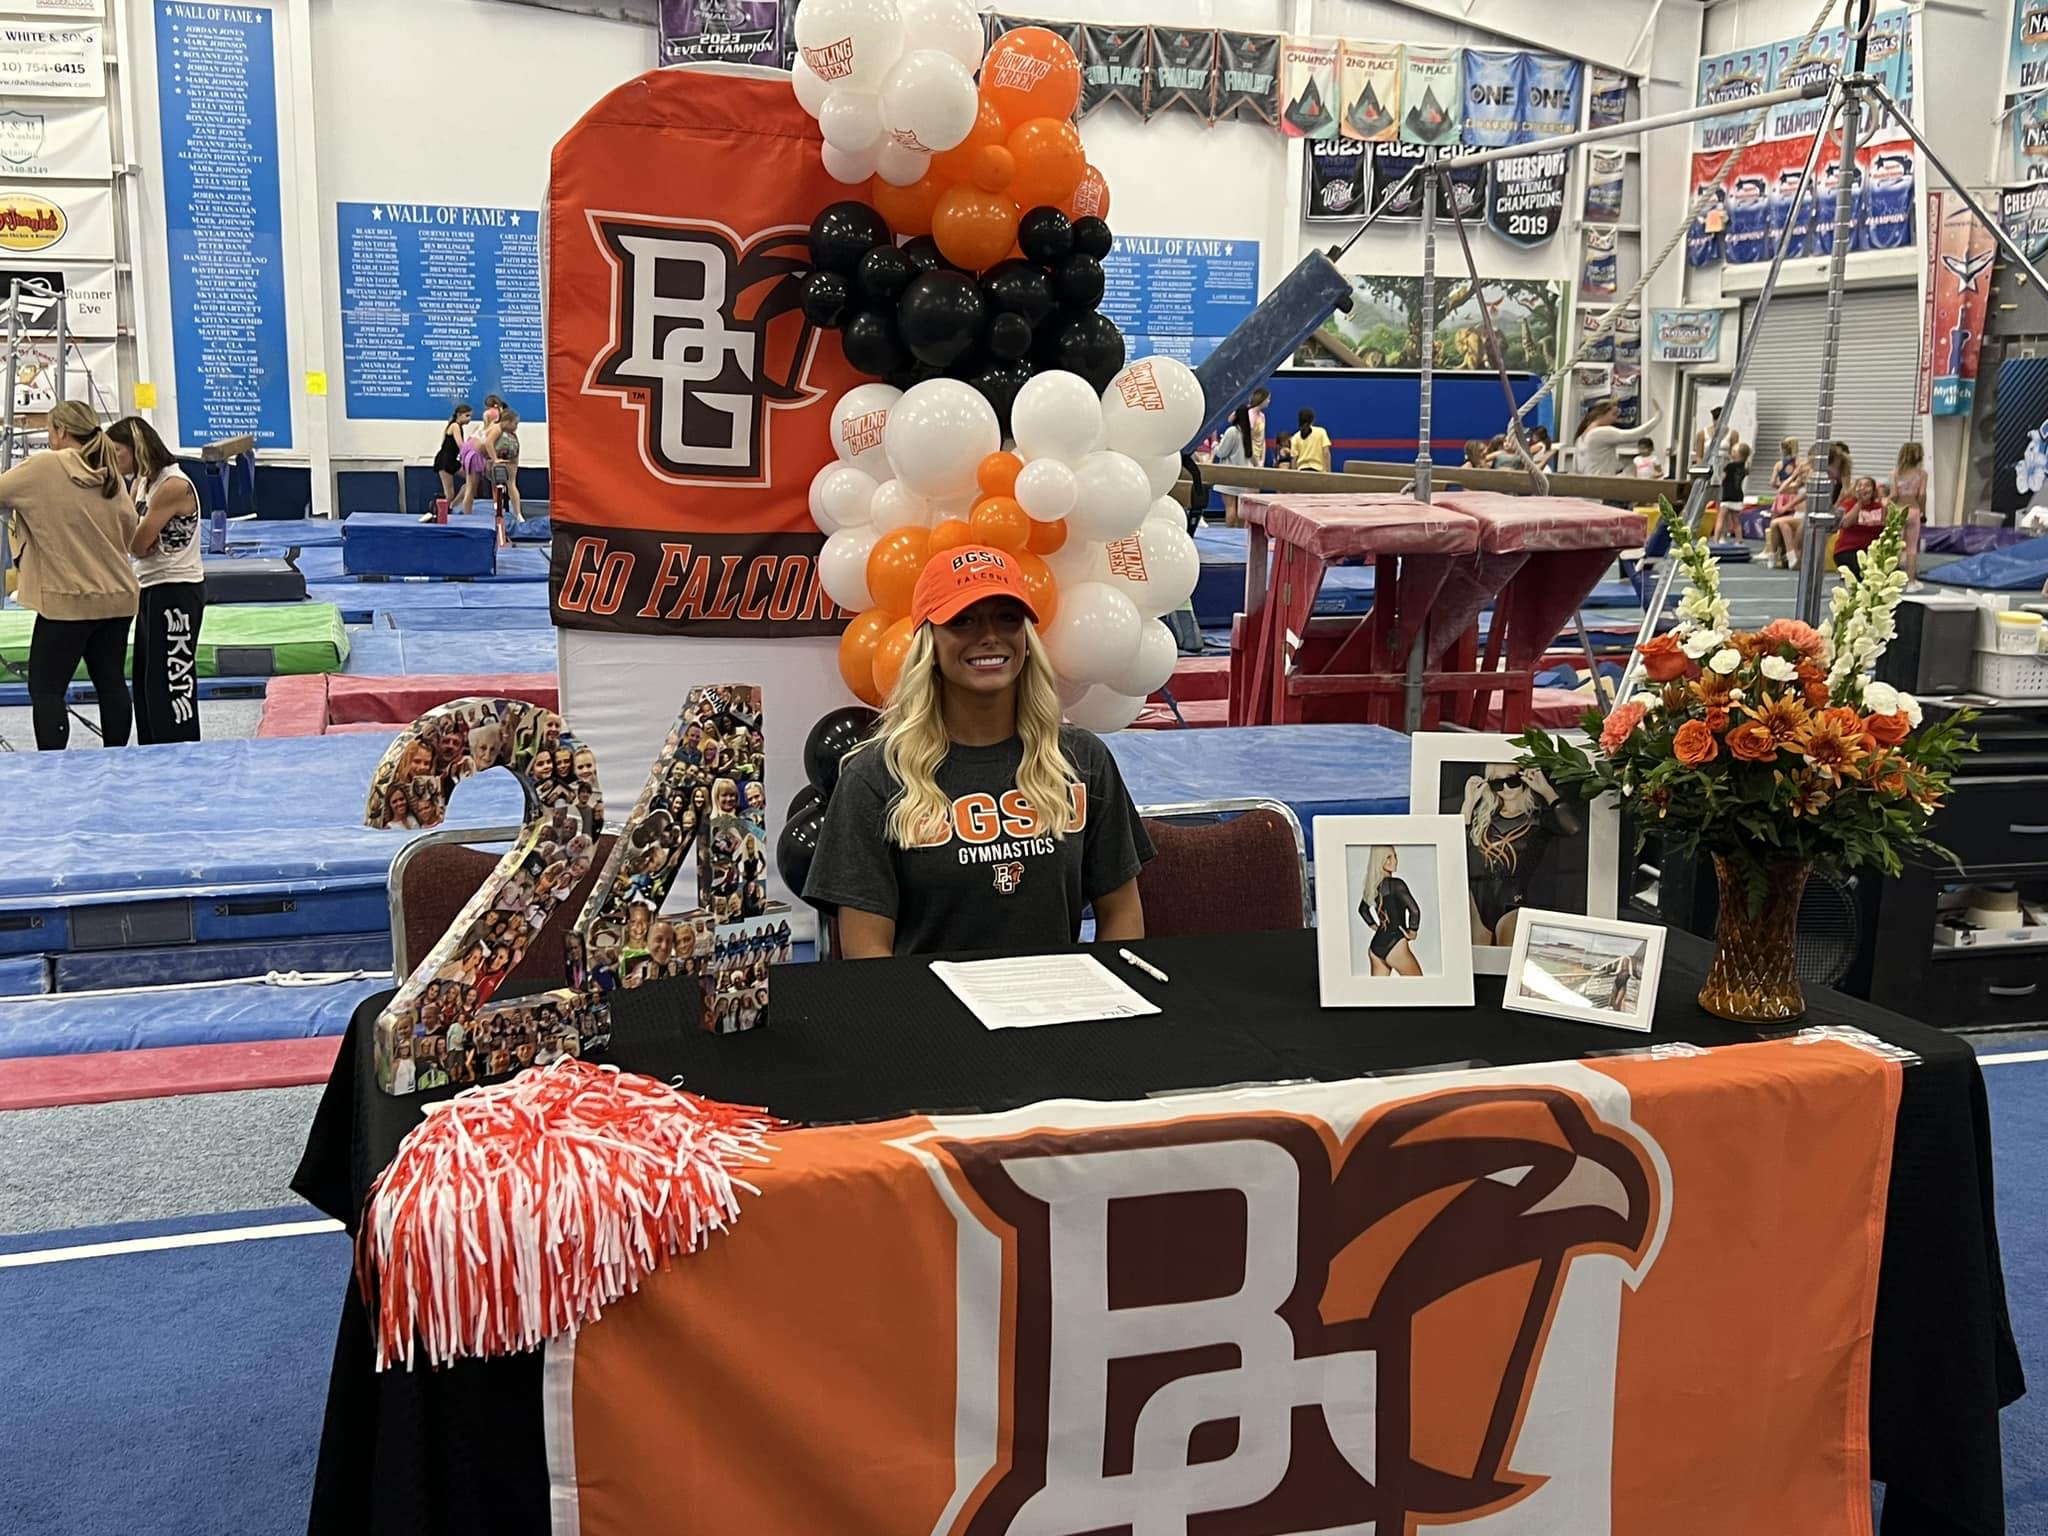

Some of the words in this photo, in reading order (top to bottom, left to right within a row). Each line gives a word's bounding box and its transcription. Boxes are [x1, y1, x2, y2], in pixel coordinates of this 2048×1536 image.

[175, 5, 205, 19] WALL
[208, 8, 222, 20] OF
[224, 9, 253, 23] FAME
[5, 31, 46, 42] WHITE
[186, 26, 217, 34] JORDAN
[700, 33, 740, 44] 2023
[210, 40, 247, 48] JOHNSON
[667, 45, 704, 56] LEVEL
[708, 42, 774, 54] CHAMPION
[26, 62, 86, 74] 754-6415
[994, 48, 1052, 80] BOWLING
[1287, 54, 1335, 66] CHAMPION
[1346, 58, 1365, 69] 2ND
[1368, 60, 1394, 70] PLACE
[212, 78, 248, 87] JOHNSON
[994, 68, 1036, 92] GREEN
[1158, 66, 1208, 90] FINALIST
[1224, 70, 1274, 94] FINALIST
[1786, 64, 1837, 88] ATIONALS
[1471, 84, 1515, 106] ONE
[1530, 87, 1570, 110] ONE
[1314, 139, 1363, 156] 2023
[1376, 140, 1424, 158] 2023
[1496, 153, 1566, 182] CHEERSPORT
[1506, 179, 1552, 196] NATIONAL
[1496, 190, 1562, 213] CHAMPIONS
[387, 206, 432, 223] WALL
[437, 207, 454, 224] OF
[463, 209, 506, 226] FAME
[1509, 215, 1548, 234] 2019
[1125, 238, 1163, 255] WALL
[1166, 240, 1184, 256] OF
[1187, 241, 1221, 256] FAME
[66, 288, 112, 300] Runner
[79, 304, 102, 314] Eve
[1664, 347, 1702, 359] FINALIST
[1130, 362, 1164, 410] BOWLING
[842, 410, 886, 442] BOWLING
[849, 428, 882, 456] GREEN
[952, 551, 1006, 572] BGSU
[1106, 540, 1128, 575] GREEN
[1122, 533, 1148, 581] OWLING
[636, 542, 861, 621] FALCON
[957, 572, 1009, 586] FALCONS
[958, 837, 1055, 865] GYMNASTICS
